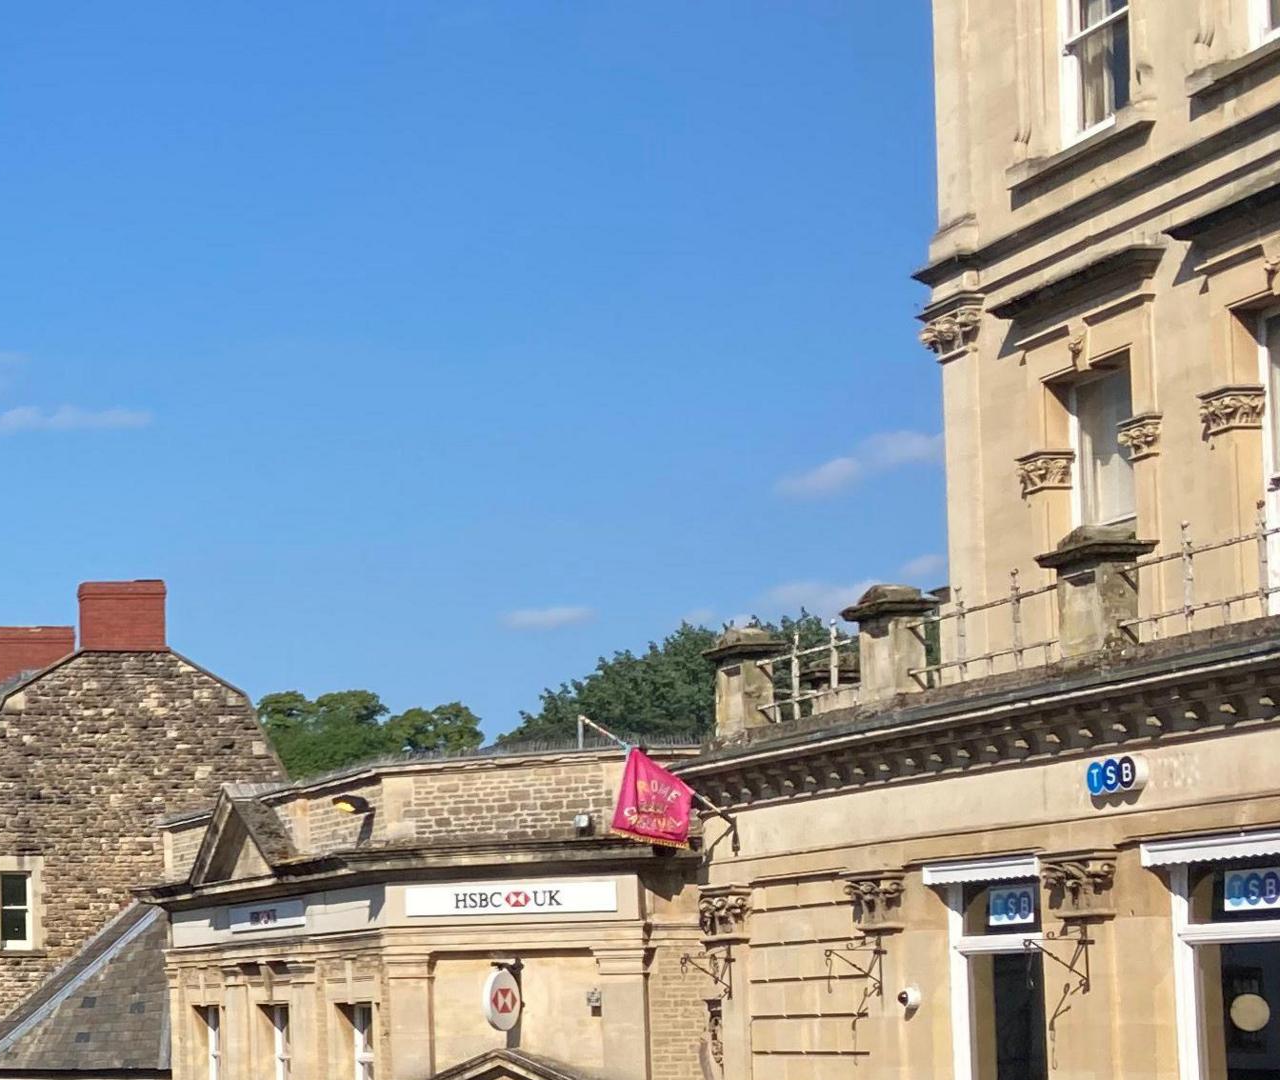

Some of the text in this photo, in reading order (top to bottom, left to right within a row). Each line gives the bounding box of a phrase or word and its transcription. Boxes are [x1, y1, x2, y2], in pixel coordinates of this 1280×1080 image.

[1090, 762, 1131, 788] TSB
[454, 890, 562, 909] HSBC UK
[1232, 877, 1277, 900] TSB
